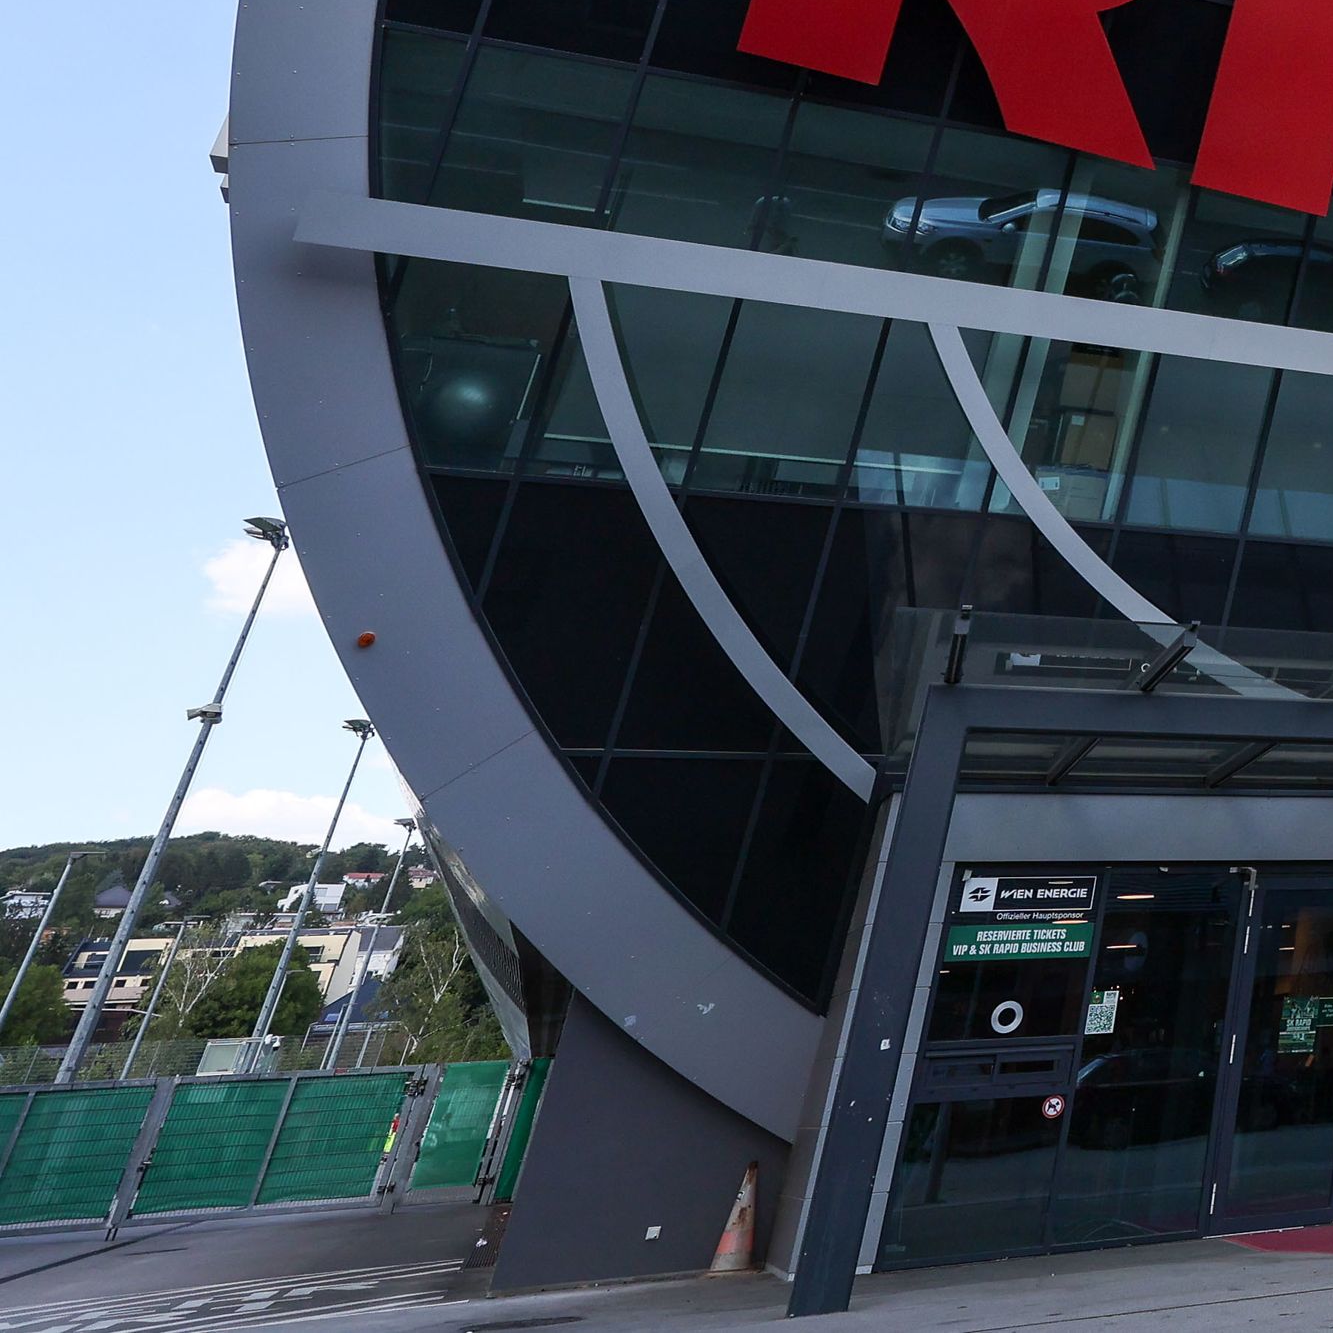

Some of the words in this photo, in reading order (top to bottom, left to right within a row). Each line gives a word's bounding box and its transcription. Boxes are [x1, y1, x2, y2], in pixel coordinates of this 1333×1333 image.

[1000, 888, 1033, 899] WIEN
[1036, 888, 1088, 899] ENERGIE
[996, 912, 1031, 920] Offizieller
[1032, 912, 1084, 921] Hauptsponsor
[976, 930, 1031, 942] RESERVIERTE
[1033, 928, 1067, 940] TICKETS
[953, 945, 968, 956] VIP
[969, 945, 977, 955] &
[978, 944, 991, 955] SK
[993, 943, 1019, 954] RAPID
[1020, 942, 1062, 954] BUSINESS
[1063, 941, 1085, 952] CLUB
